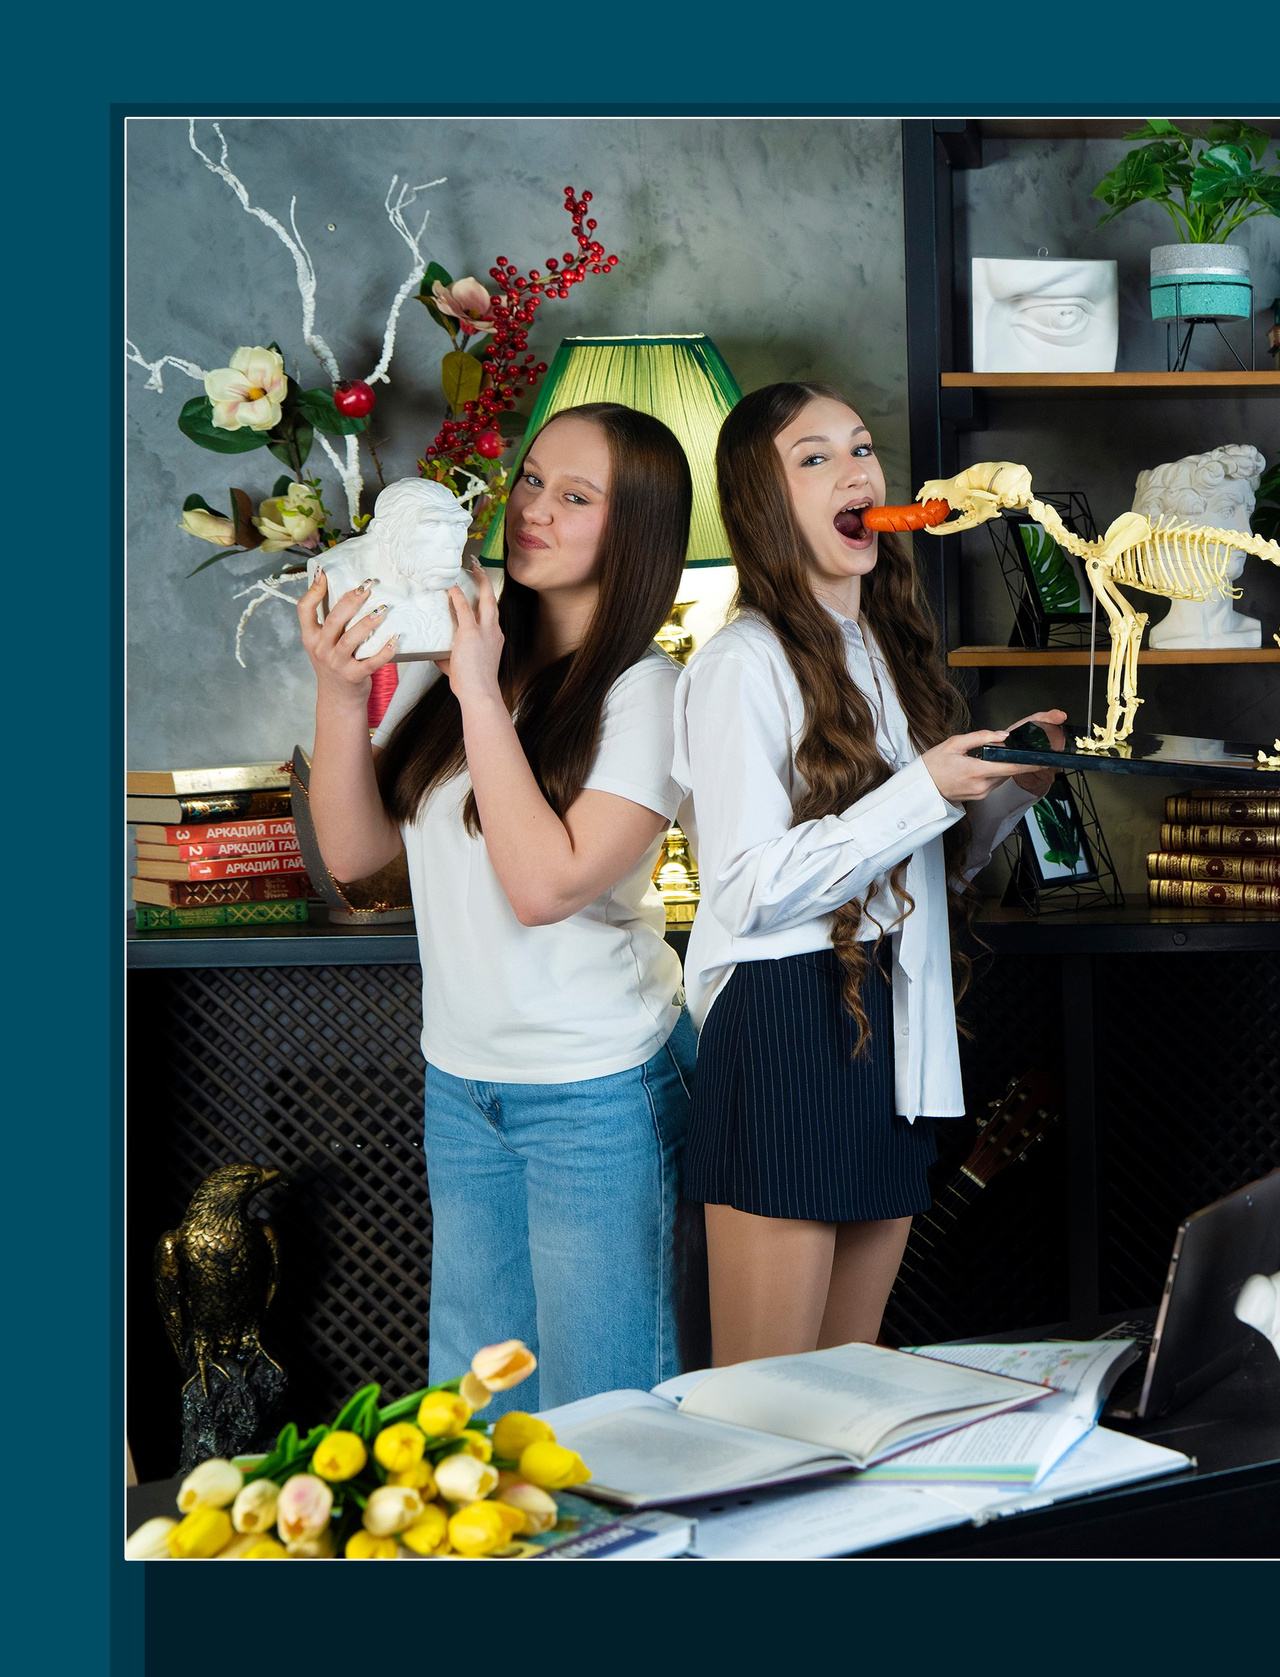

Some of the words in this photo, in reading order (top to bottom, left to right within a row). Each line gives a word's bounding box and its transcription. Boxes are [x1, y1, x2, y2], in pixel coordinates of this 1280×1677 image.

[176, 829, 191, 841] 3
[206, 823, 267, 839] АРКАДИЙ
[188, 845, 204, 857] 2
[218, 840, 276, 855] АРКАДИЙ
[199, 866, 212, 874] 1
[226, 858, 280, 875] АРКАДИЙ
[282, 856, 307, 869] ГАЙ
